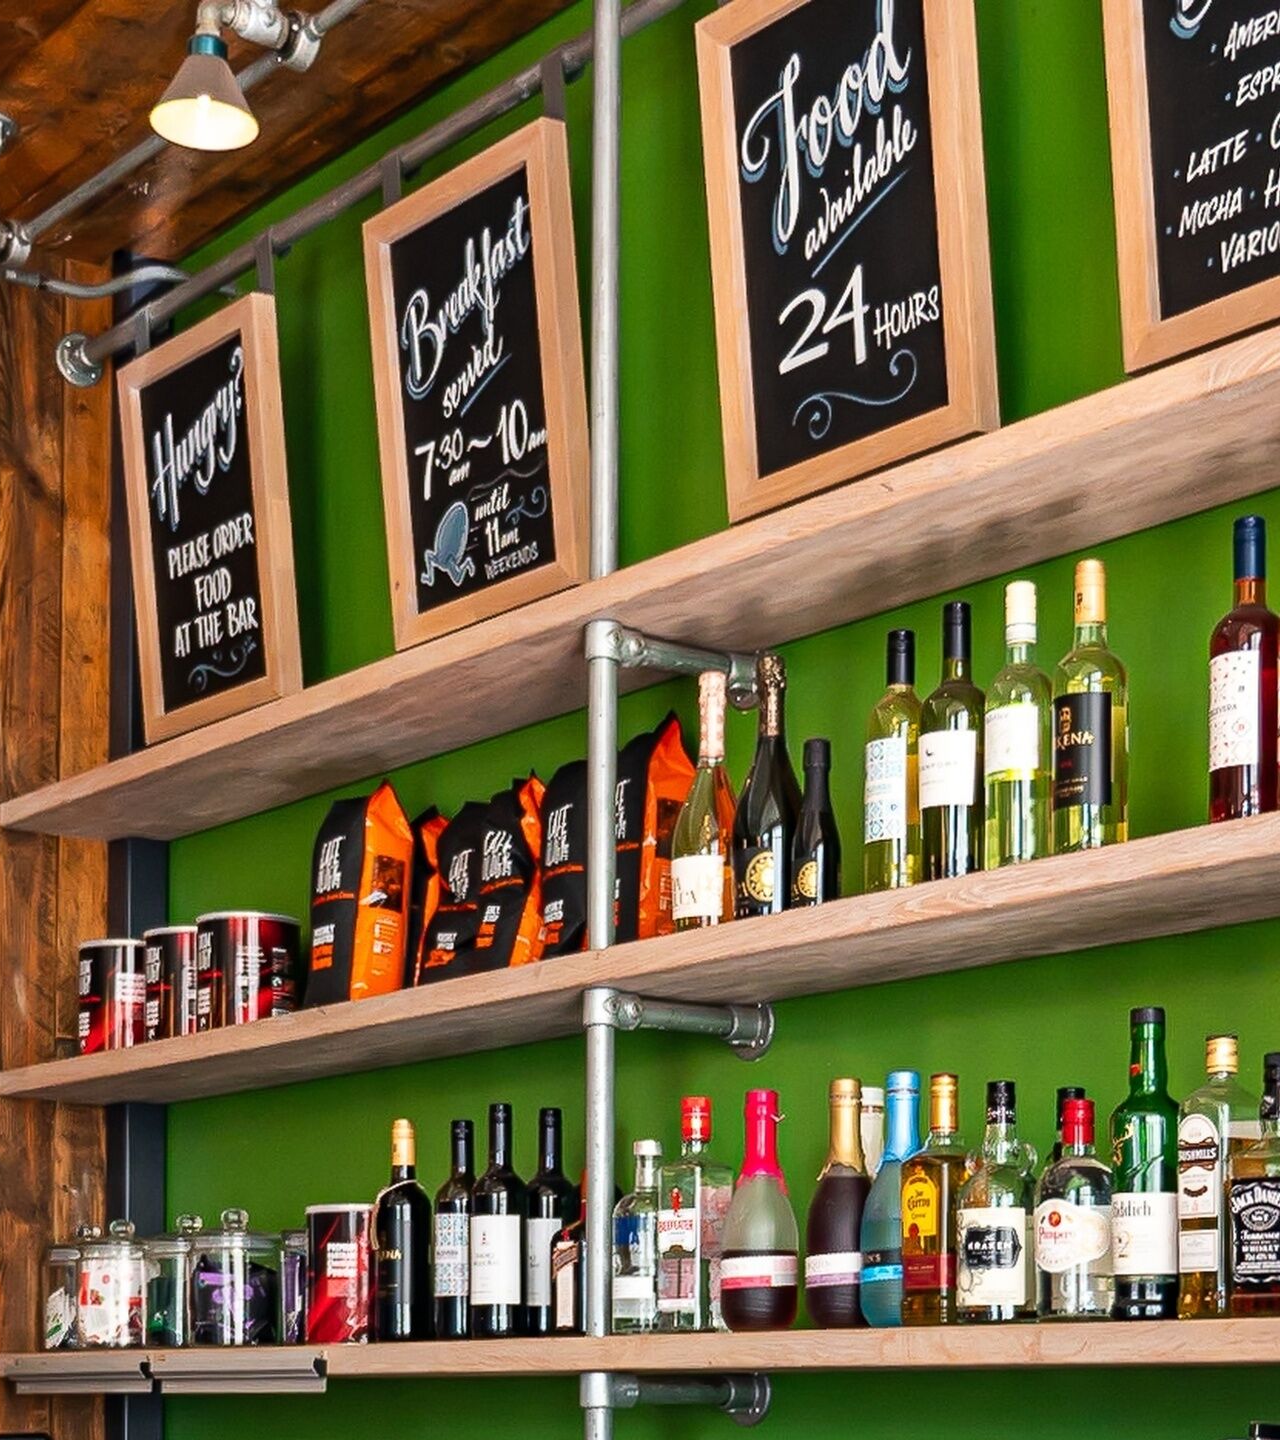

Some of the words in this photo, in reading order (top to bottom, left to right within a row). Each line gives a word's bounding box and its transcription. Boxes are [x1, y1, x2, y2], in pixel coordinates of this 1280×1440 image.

[741, 0, 911, 256] Food
[1187, 130, 1249, 183] LATTE
[803, 106, 917, 259] available
[1178, 187, 1243, 238] MOCHA
[401, 196, 530, 399] Breakfast
[777, 265, 870, 378] 24
[873, 285, 940, 351] HOURS
[443, 336, 503, 418] served
[152, 346, 245, 531] Hungry?
[474, 486, 512, 522] until
[168, 531, 212, 580] PLEASE
[213, 513, 253, 562] ORDER
[485, 542, 539, 580] WEEKENDS
[195, 567, 232, 612] FOOD
[174, 621, 193, 659] AT
[194, 610, 224, 648] THE
[227, 598, 259, 640] BAR
[1055, 730, 1096, 750] KENA
[1231, 1191, 1255, 1214] JACK
[967, 1240, 1014, 1252] KRAKEN
